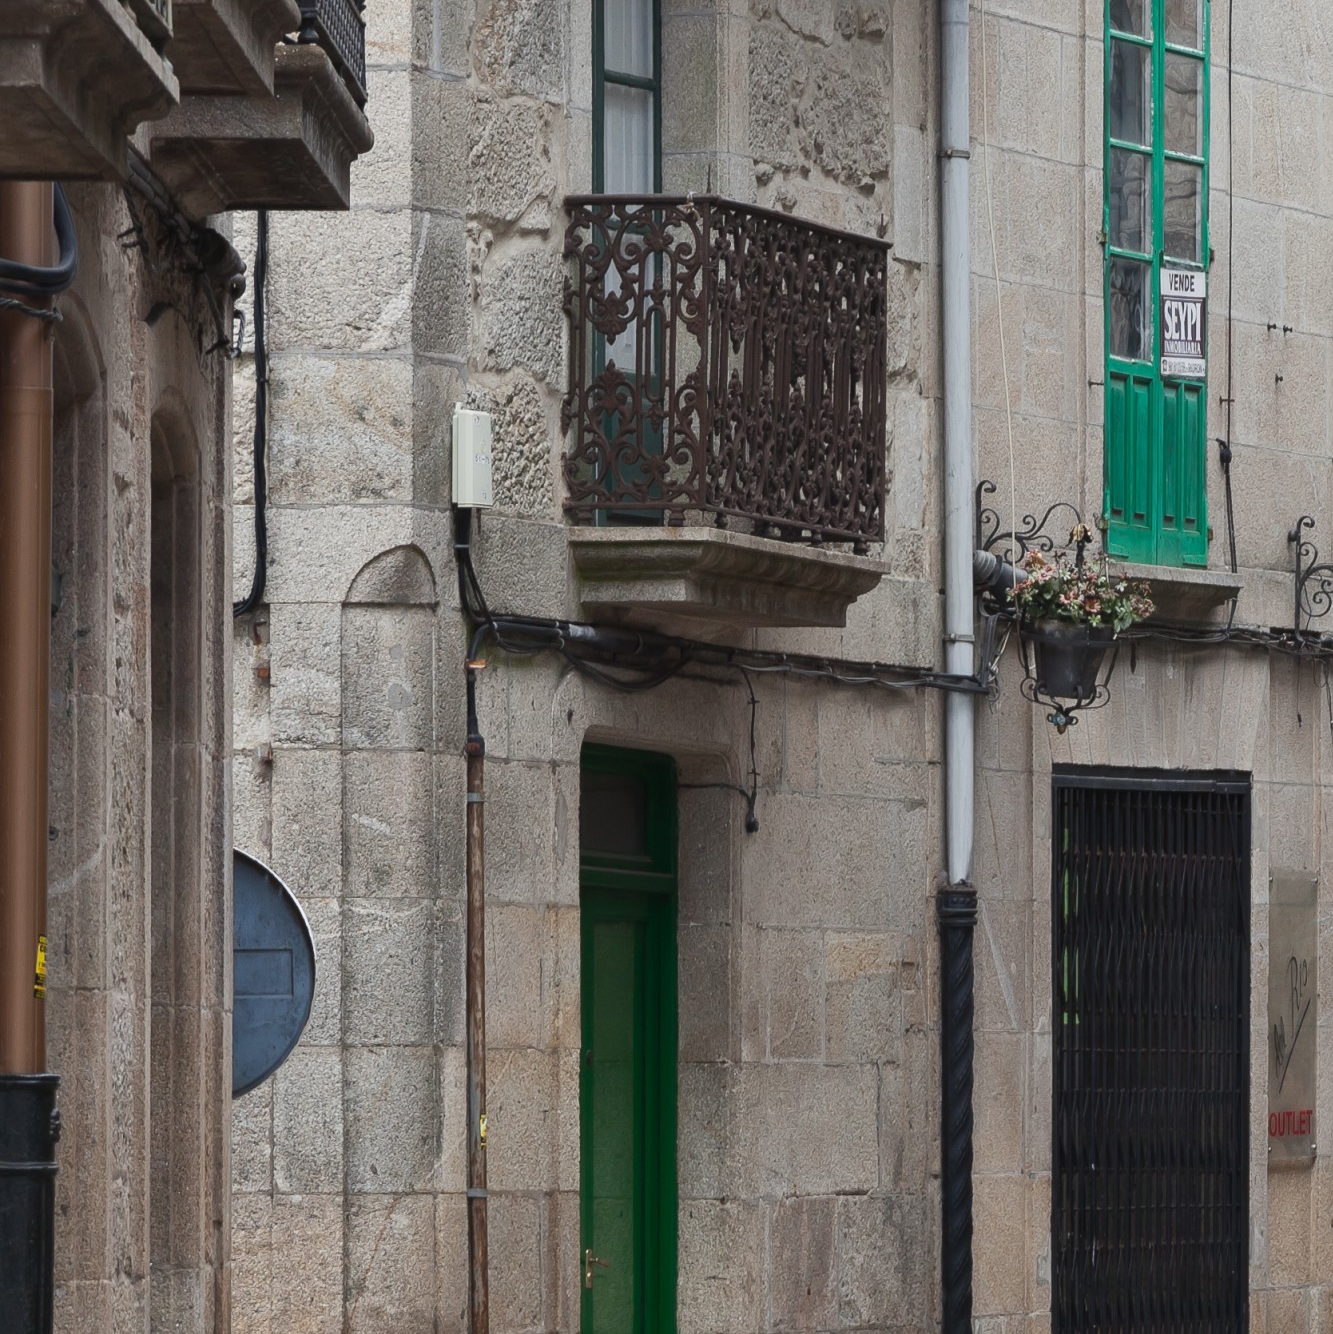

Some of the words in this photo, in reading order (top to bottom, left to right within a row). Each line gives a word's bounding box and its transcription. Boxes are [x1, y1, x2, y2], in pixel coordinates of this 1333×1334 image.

[1168, 273, 1195, 292] VENDE
[1164, 299, 1202, 341] SEYPI
[1164, 340, 1202, 355] INMOBILIARIA
[1268, 1109, 1313, 1137] OUTLET
